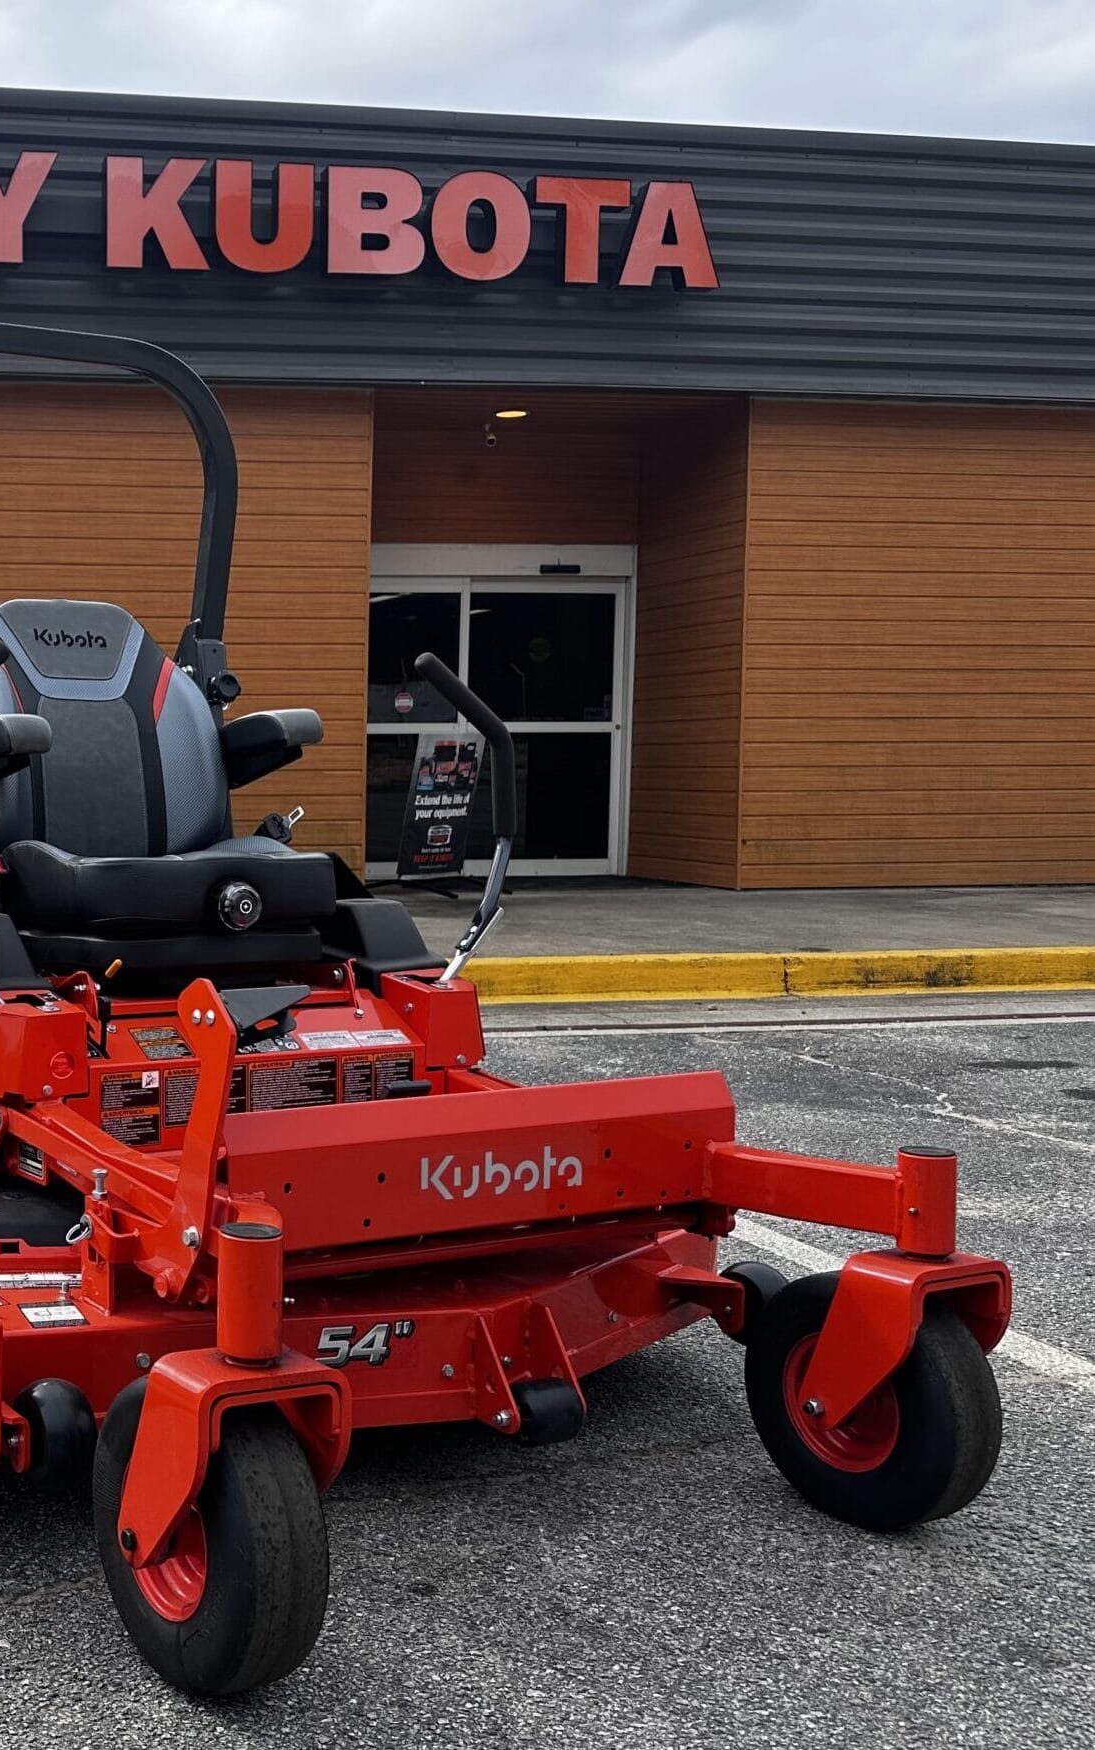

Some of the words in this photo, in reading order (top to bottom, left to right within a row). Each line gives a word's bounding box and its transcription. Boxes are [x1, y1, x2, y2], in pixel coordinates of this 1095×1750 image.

[105, 154, 720, 290] KUBOTA
[33, 627, 108, 649] Kubota
[415, 795, 441, 805] Extend
[441, 794, 453, 805] the
[453, 793, 464, 804] life
[415, 809, 433, 820] your
[420, 1146, 583, 1200] Kubota
[314, 1319, 414, 1367] 54"
